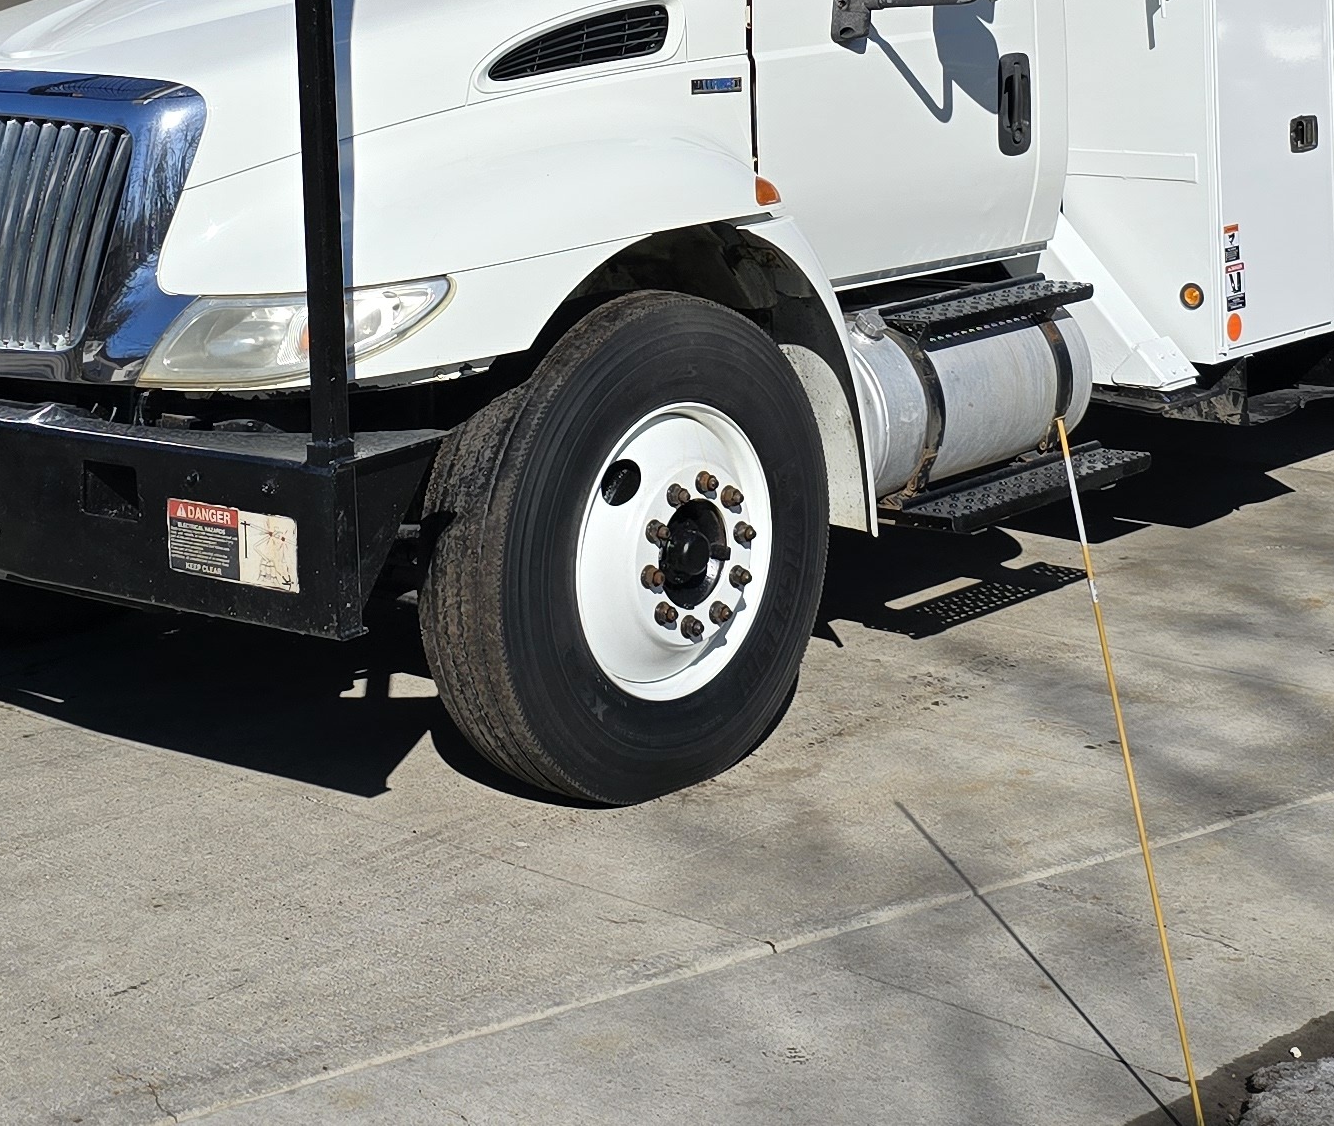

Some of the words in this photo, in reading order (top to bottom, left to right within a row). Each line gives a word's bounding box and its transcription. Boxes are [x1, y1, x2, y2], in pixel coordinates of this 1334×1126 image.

[187, 506, 231, 525] DANGER
[185, 562, 201, 571] KEEP
[202, 564, 223, 576] CLEAR
